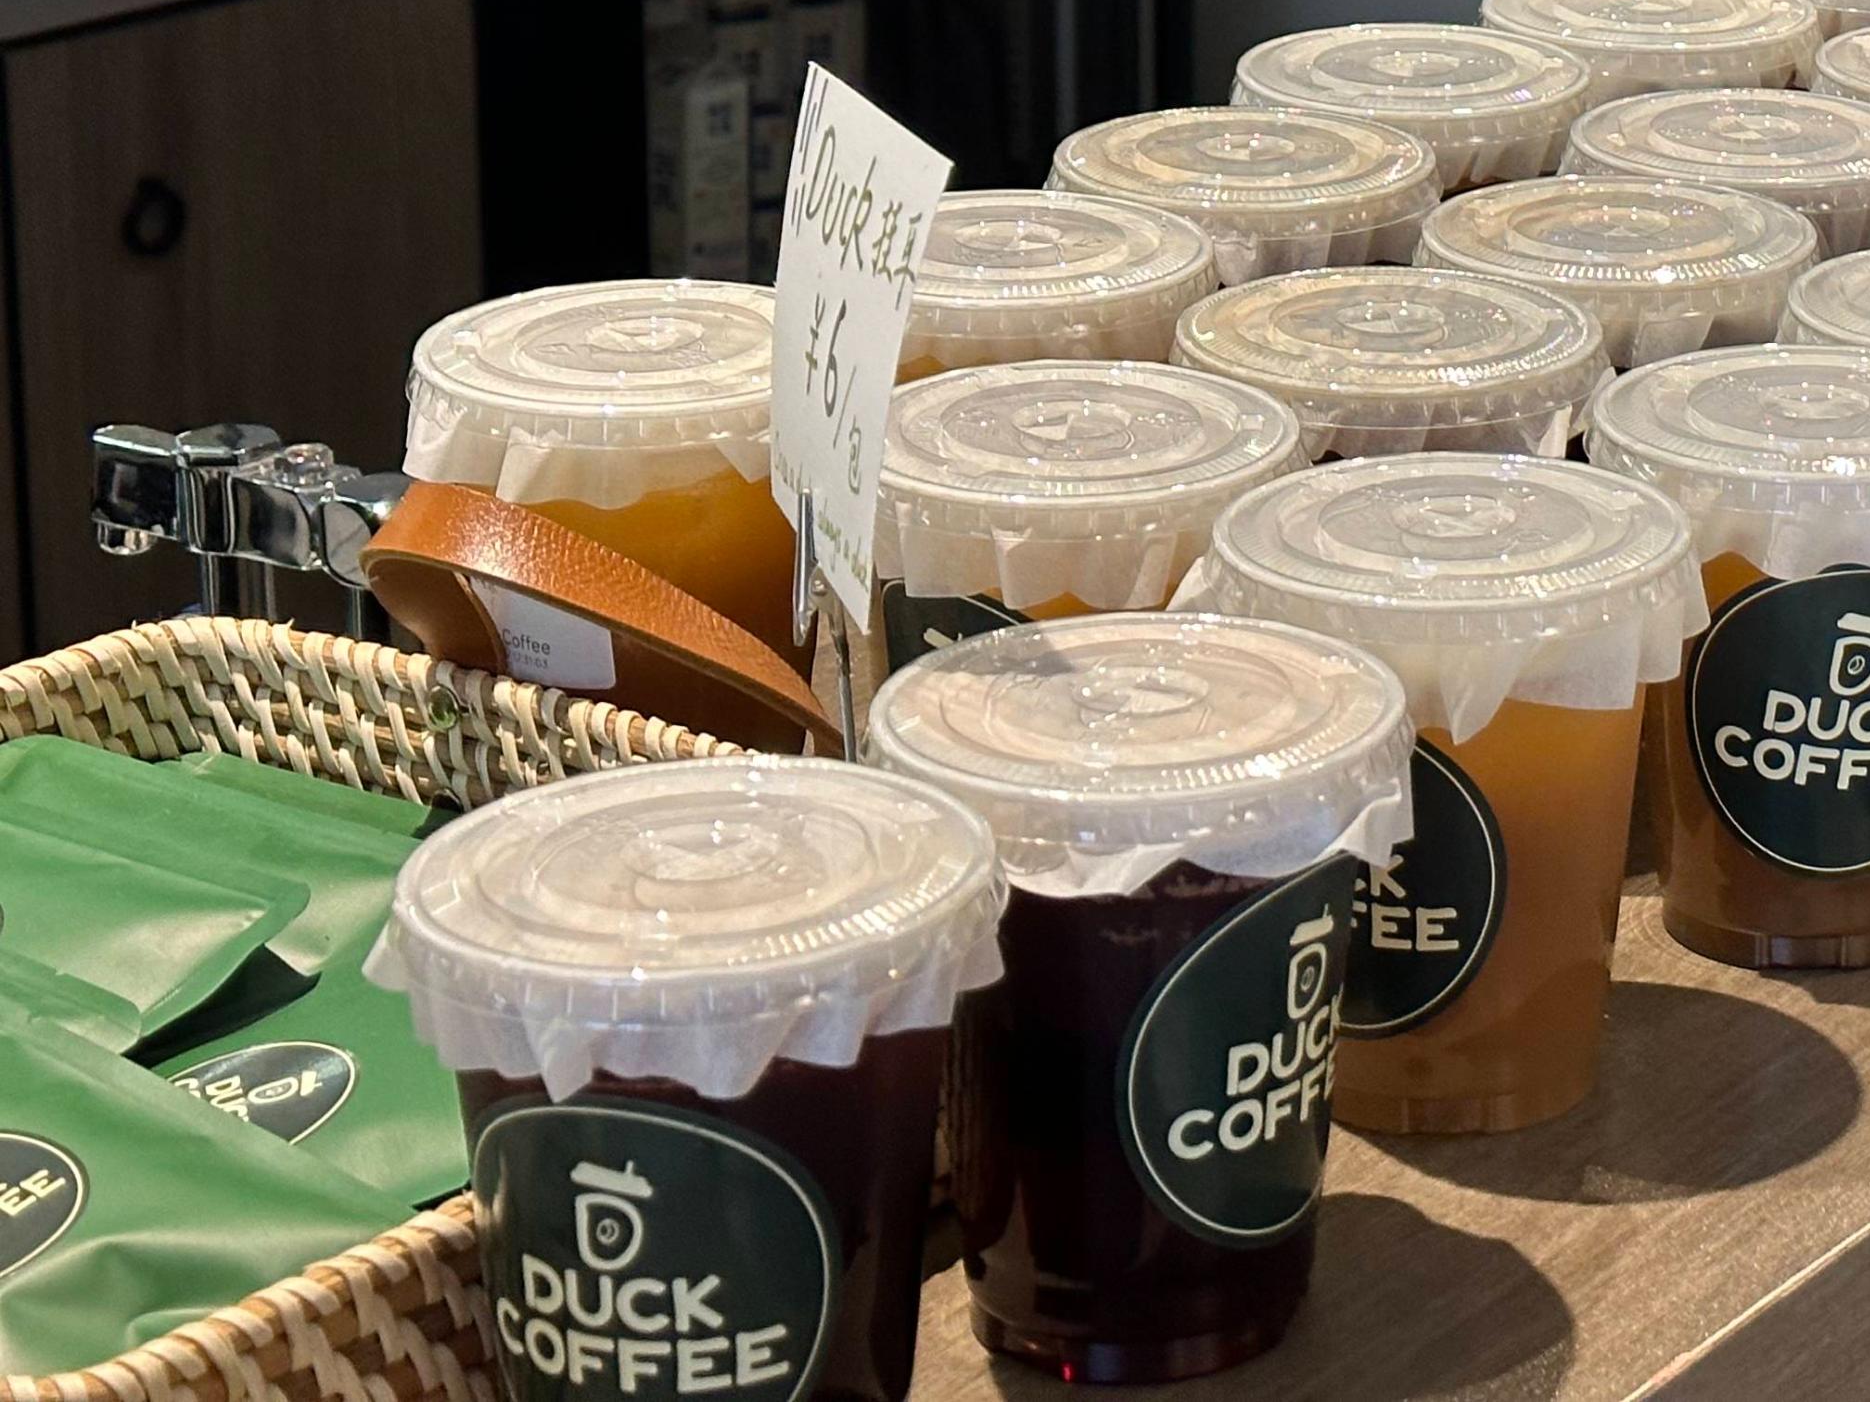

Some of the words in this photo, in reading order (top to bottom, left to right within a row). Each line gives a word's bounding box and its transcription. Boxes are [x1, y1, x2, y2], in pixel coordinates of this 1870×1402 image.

[502, 628, 551, 656] Coffee
[1167, 1045, 1338, 1160] COFFE
[522, 1253, 724, 1333] DUCK
[497, 1297, 790, 1394] COFFEE
